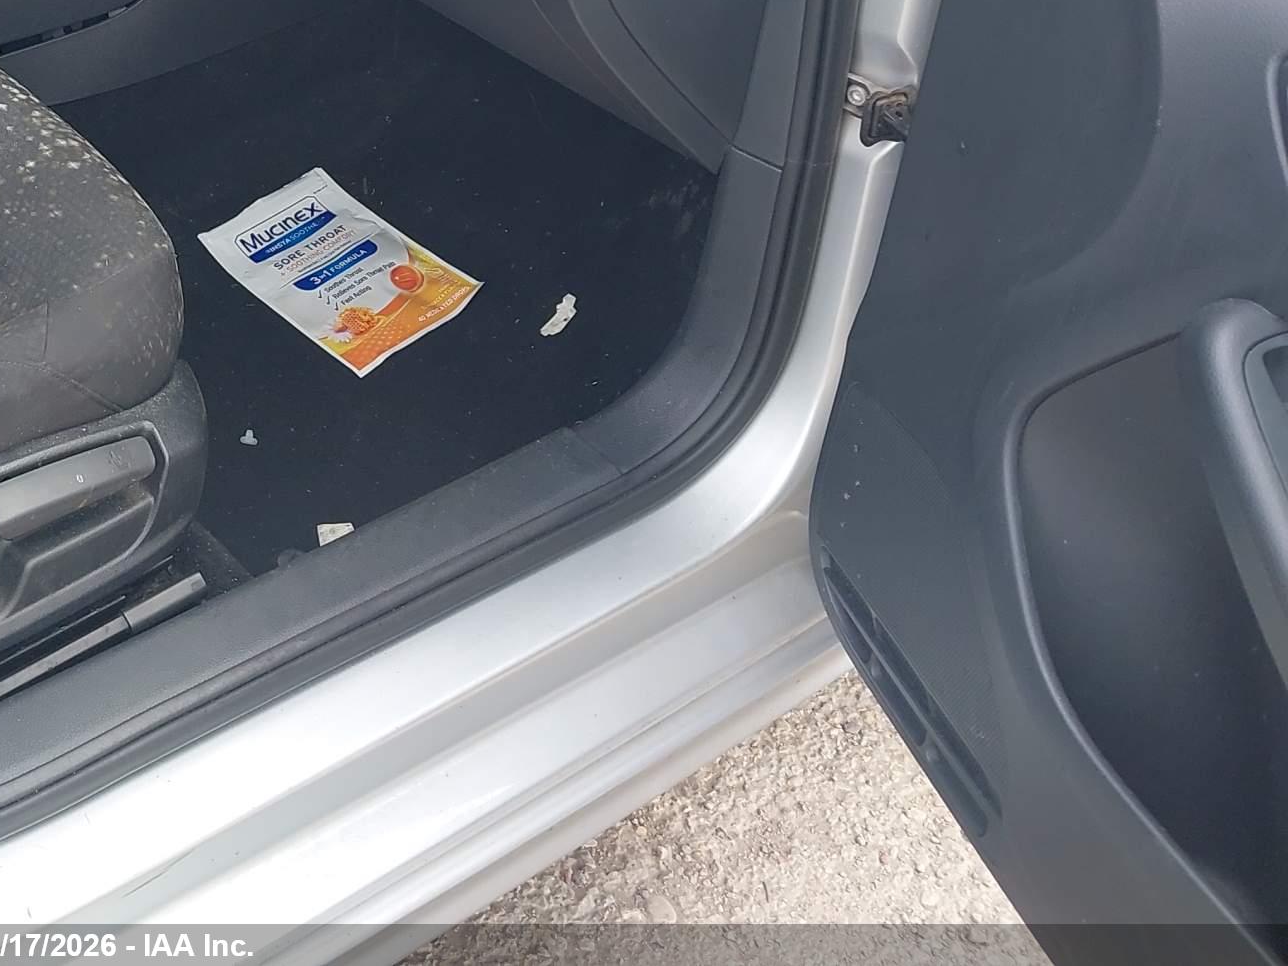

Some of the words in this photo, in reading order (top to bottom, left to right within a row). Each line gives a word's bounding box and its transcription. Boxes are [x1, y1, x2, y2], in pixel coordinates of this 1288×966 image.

[273, 249, 306, 271] SORE
[304, 224, 348, 251] THROAT
[330, 249, 368, 273] FORMULA
[346, 267, 364, 282] Throat
[353, 284, 373, 299] Acting
